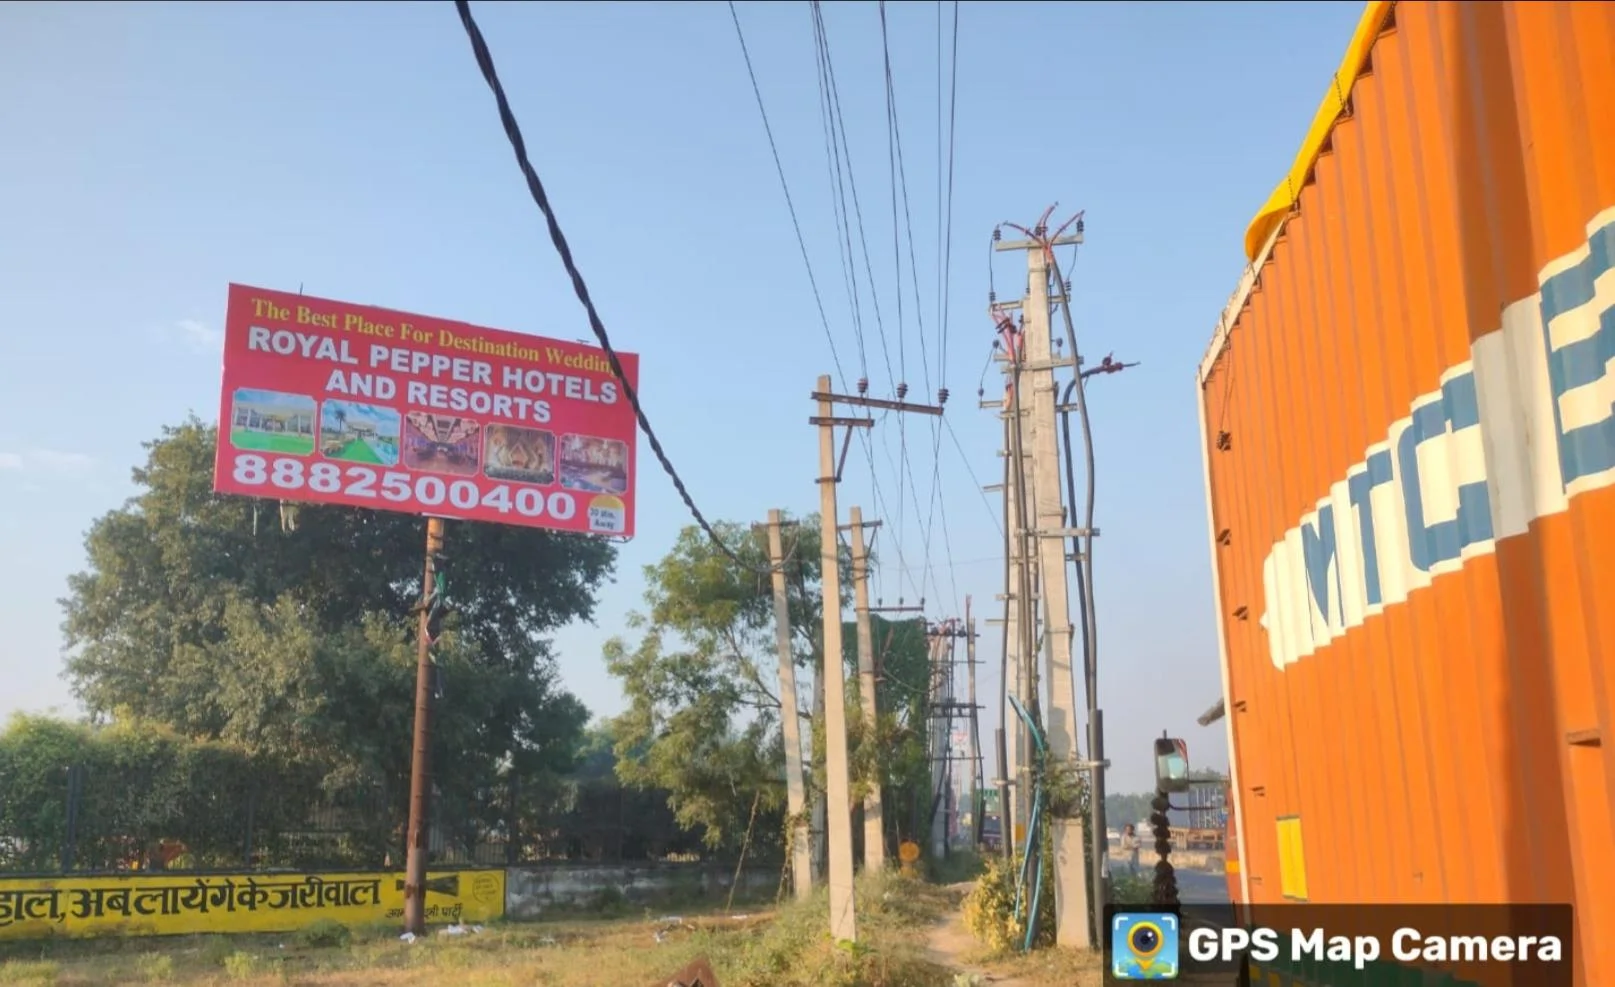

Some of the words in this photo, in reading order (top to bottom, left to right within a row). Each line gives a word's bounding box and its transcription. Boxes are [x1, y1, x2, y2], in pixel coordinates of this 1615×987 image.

[252, 298, 290, 321] The
[297, 306, 339, 330] Best
[344, 314, 395, 339] Place
[400, 322, 432, 346] For
[438, 330, 540, 362] Destination
[248, 326, 359, 365] ROYAL
[370, 343, 492, 386] PEPPER
[502, 365, 618, 405] HOTELS
[325, 369, 396, 400] AND
[407, 380, 551, 424] RESORTS
[232, 454, 577, 521] 8882500400
